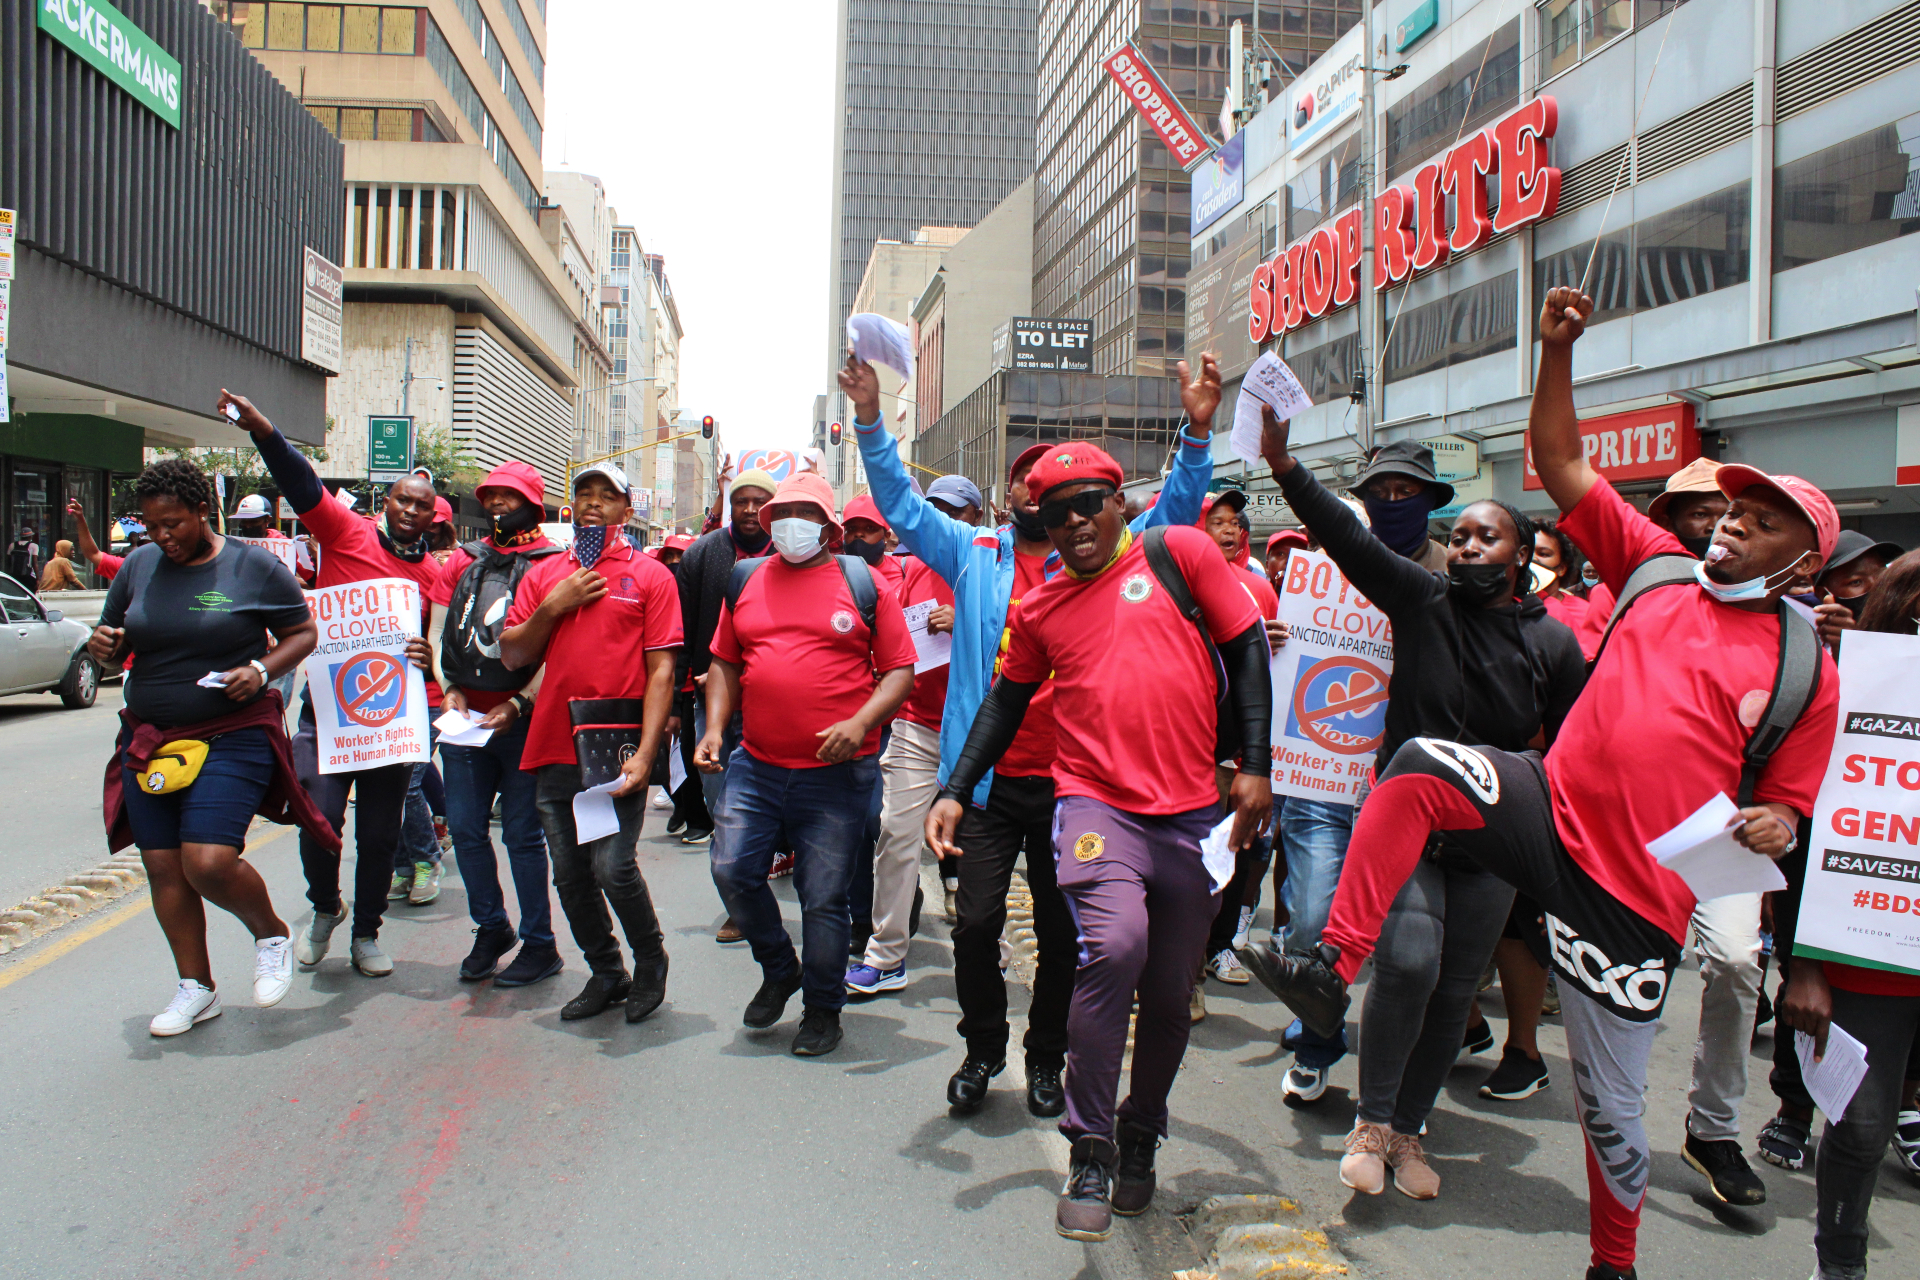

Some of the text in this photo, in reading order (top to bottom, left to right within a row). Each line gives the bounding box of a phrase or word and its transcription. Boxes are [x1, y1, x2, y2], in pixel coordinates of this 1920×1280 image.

[45, 0, 178, 110] ACKERMANS
[1317, 53, 1362, 101] CAPITEC
[1112, 54, 1198, 159] SHOPRITE
[1340, 91, 1356, 113] atm
[1195, 179, 1238, 225] Crusaders
[1249, 94, 1562, 344] SHOPRITE
[316, 265, 341, 301] trafalgar
[1017, 320, 1089, 331] OFFICE SPACE
[1016, 331, 1089, 349] TO LET
[1527, 421, 1677, 476] PRITE
[328, 615, 401, 640] CLOVER
[1288, 626, 1336, 648] ANCTION
[1313, 606, 1393, 644] CLOVE
[351, 634, 393, 652] APARTHEID
[334, 726, 414, 749] Worker's Rights
[330, 741, 421, 765] are Human Rights
[1272, 745, 1343, 774] Worker's
[1290, 771, 1346, 795] Human
[1842, 754, 1920, 791] STO
[1831, 807, 1920, 846] GEN
[1827, 854, 1920, 882] #SAVESH
[1853, 889, 1920, 917] #BDS
[1847, 926, 1891, 937] FREEDOM
